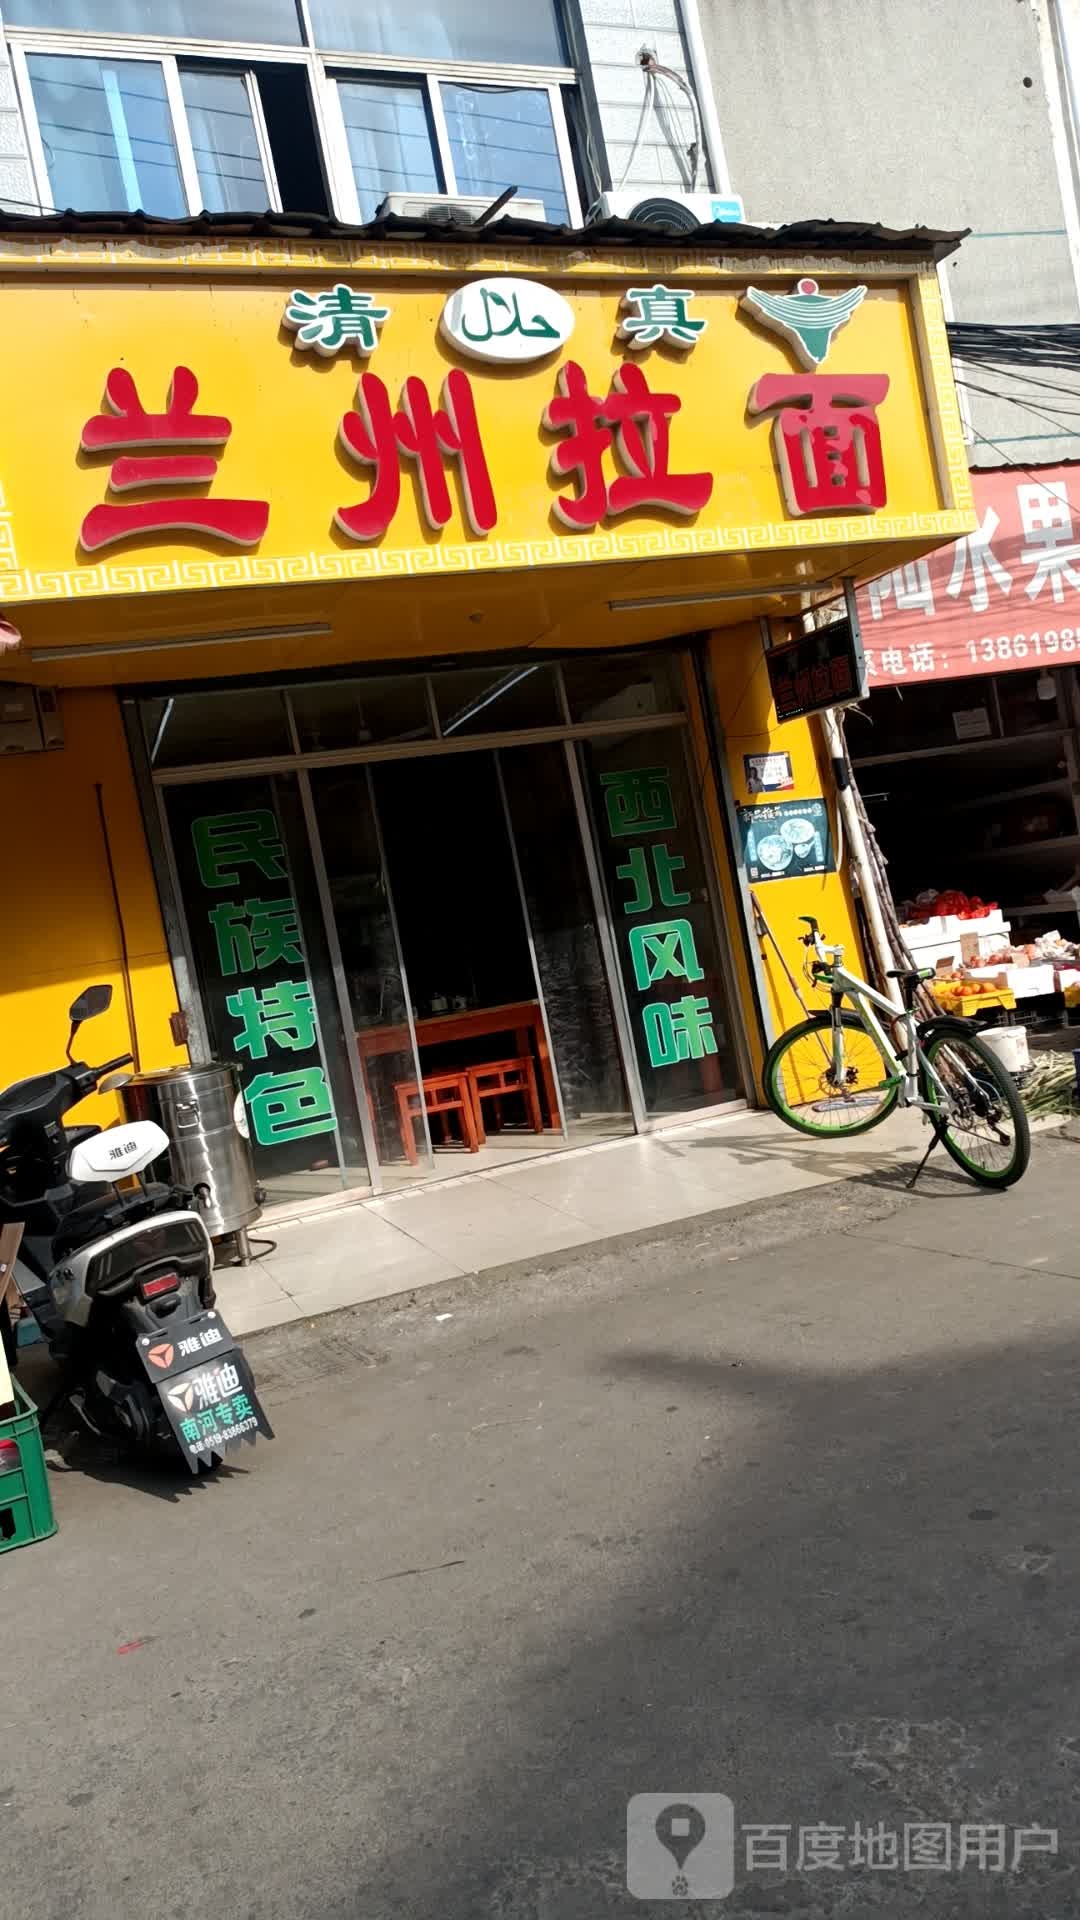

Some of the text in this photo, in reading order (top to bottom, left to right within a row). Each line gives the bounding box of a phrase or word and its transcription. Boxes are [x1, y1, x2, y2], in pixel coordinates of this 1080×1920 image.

[80, 360, 890, 552] 兰州拉面
[600, 766, 719, 1068] 西北风味
[191, 808, 338, 1146] 民族特色
[109, 1141, 137, 1160] 雅迪
[177, 1327, 223, 1357] 雅迪
[192, 1362, 243, 1411] 雅迪
[179, 1394, 254, 1442] 南河专卖
